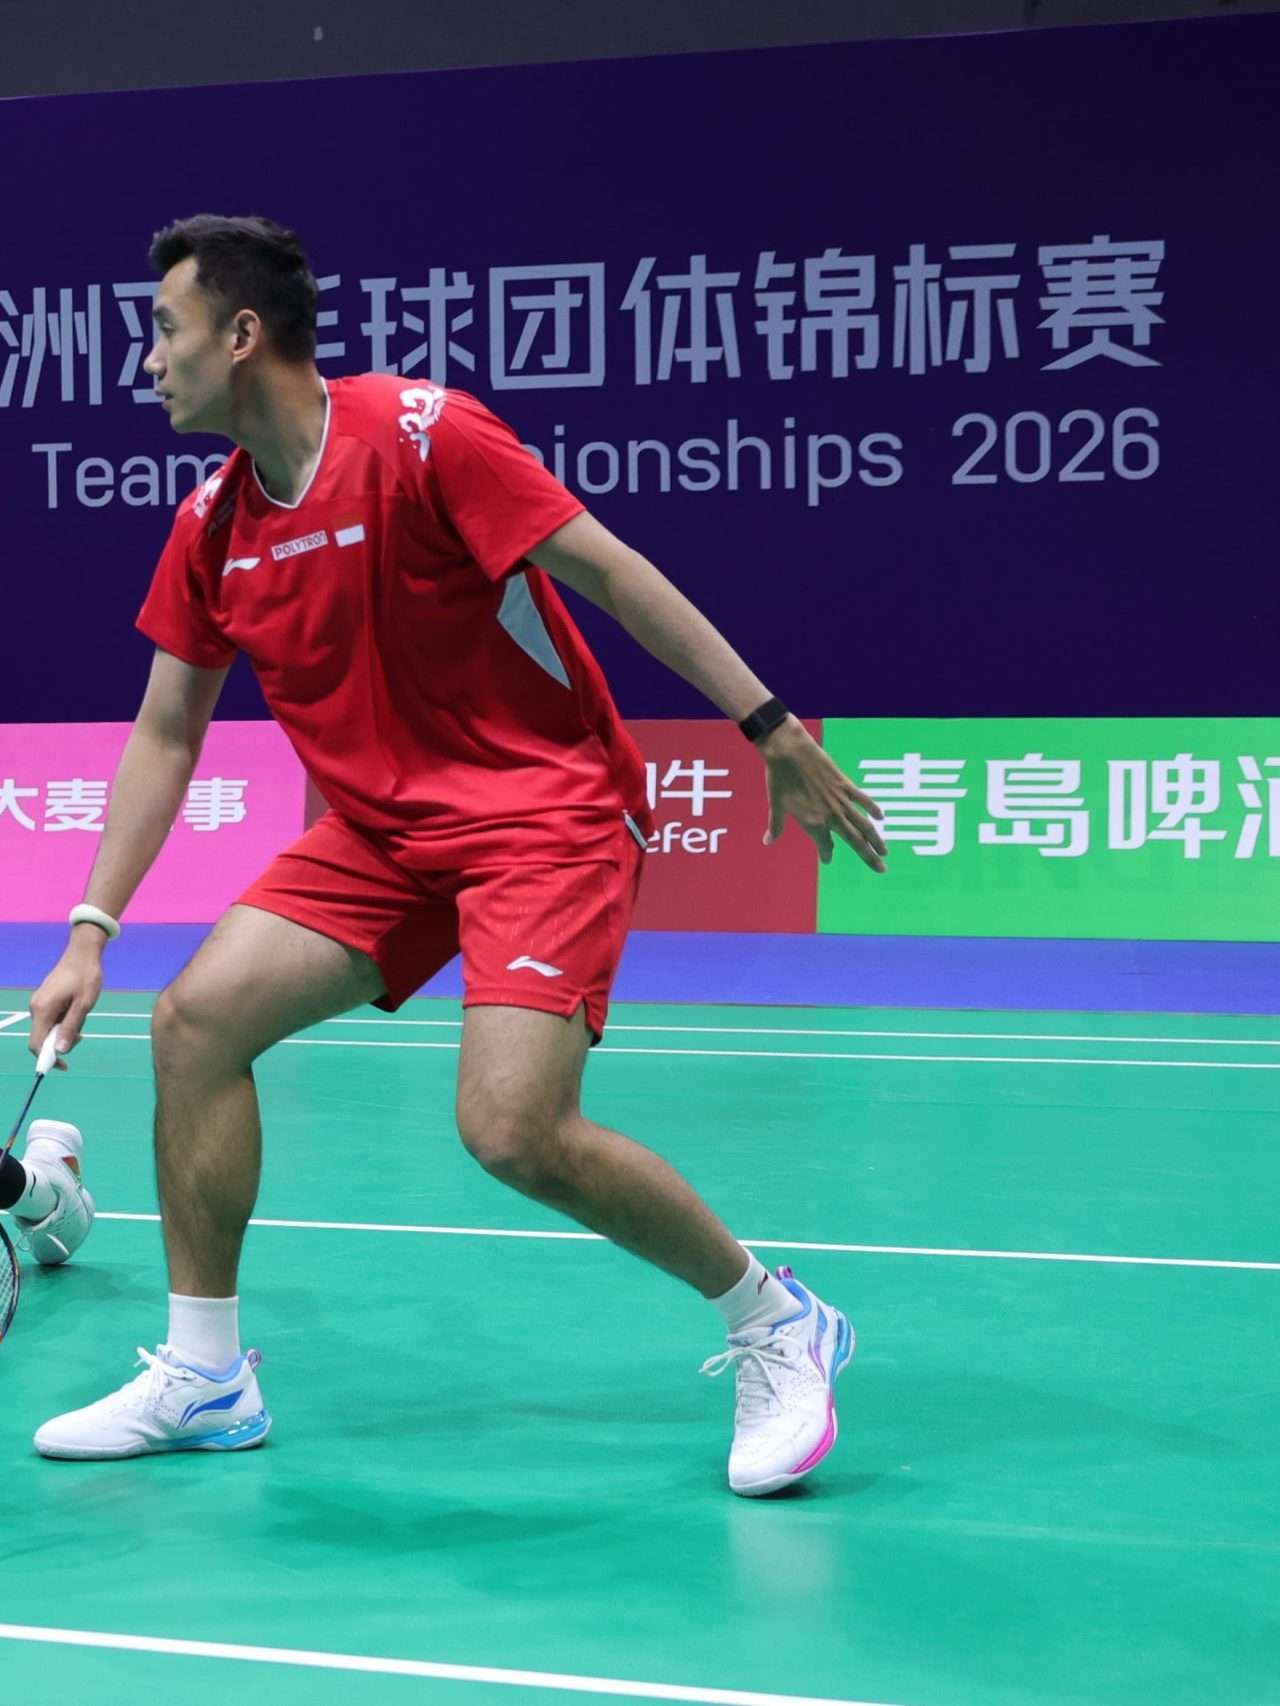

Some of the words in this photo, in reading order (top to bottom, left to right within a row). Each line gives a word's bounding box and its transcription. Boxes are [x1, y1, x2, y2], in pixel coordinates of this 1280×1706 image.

[31, 442, 227, 509] Team
[953, 408, 1160, 484] 2026
[274, 531, 328, 559] POLYTRON
[645, 759, 733, 816] 牛
